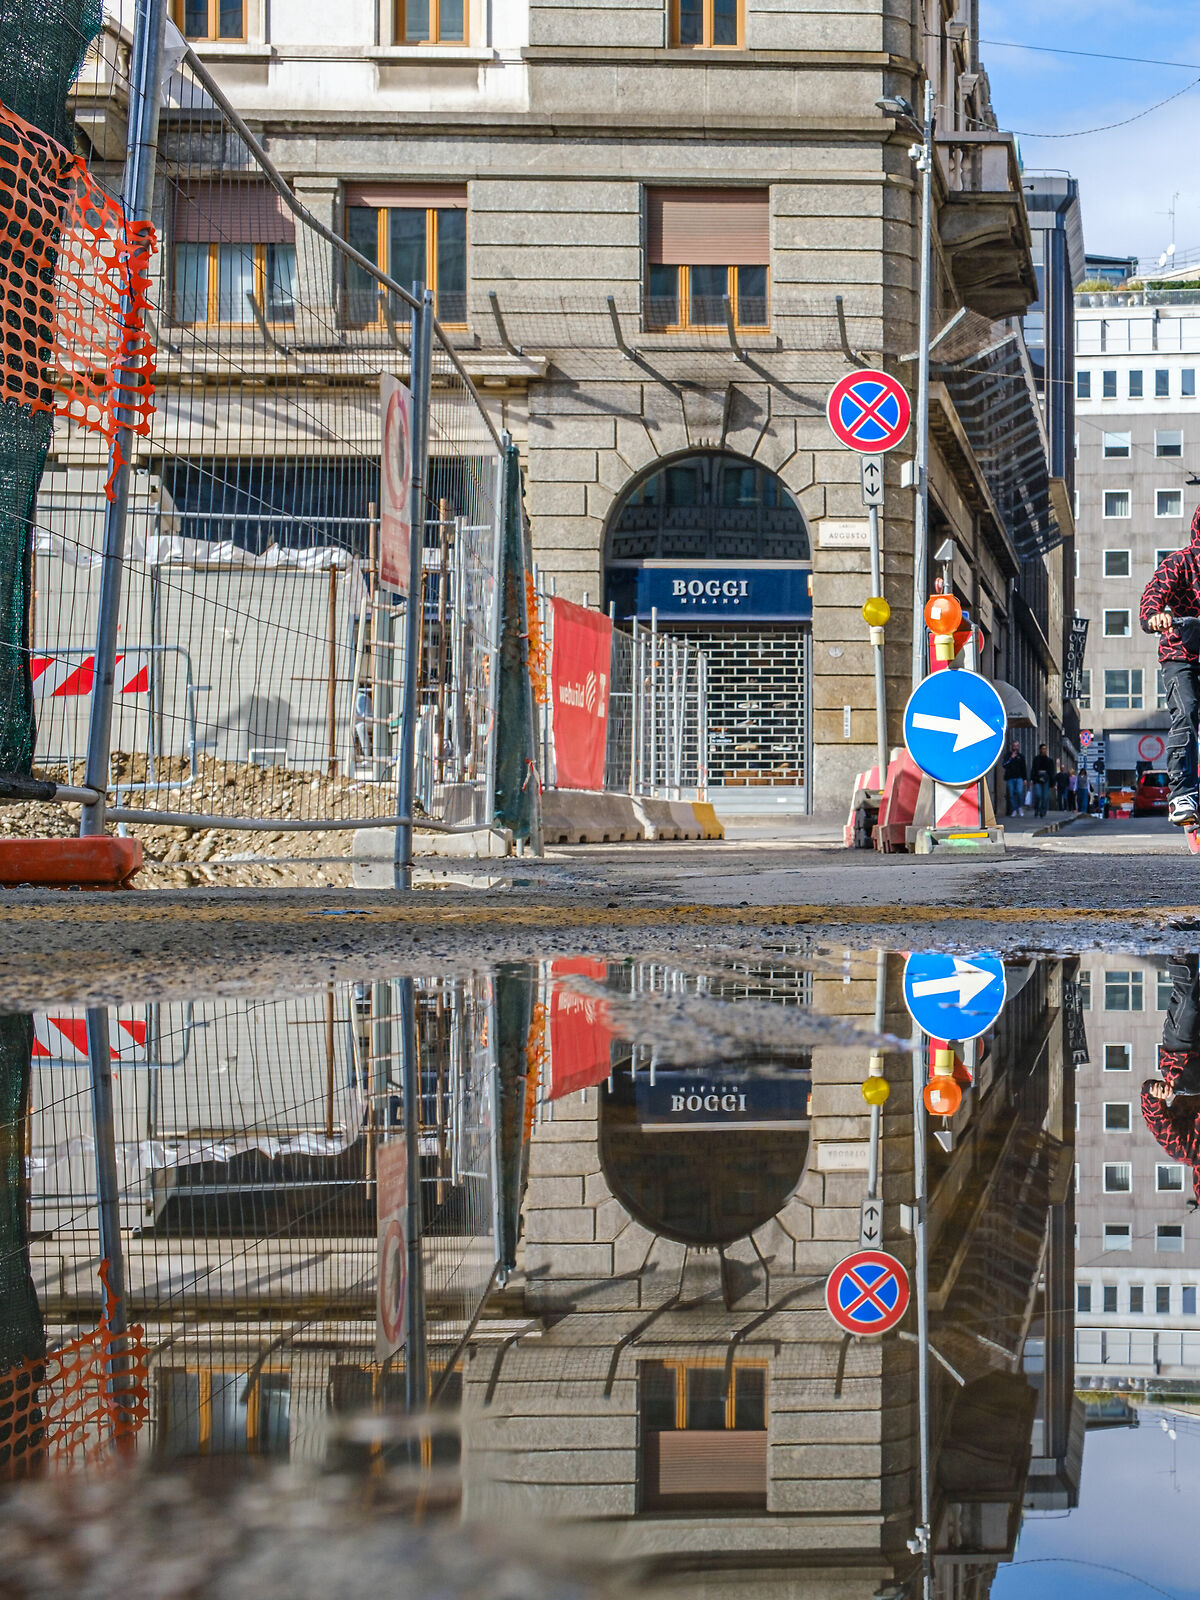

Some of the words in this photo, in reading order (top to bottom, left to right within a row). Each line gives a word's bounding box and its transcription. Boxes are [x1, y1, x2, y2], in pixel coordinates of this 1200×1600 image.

[829, 532, 867, 540] AUGUSTO
[672, 579, 748, 597] BOGGI
[1064, 633, 1077, 698] OROLOGI
